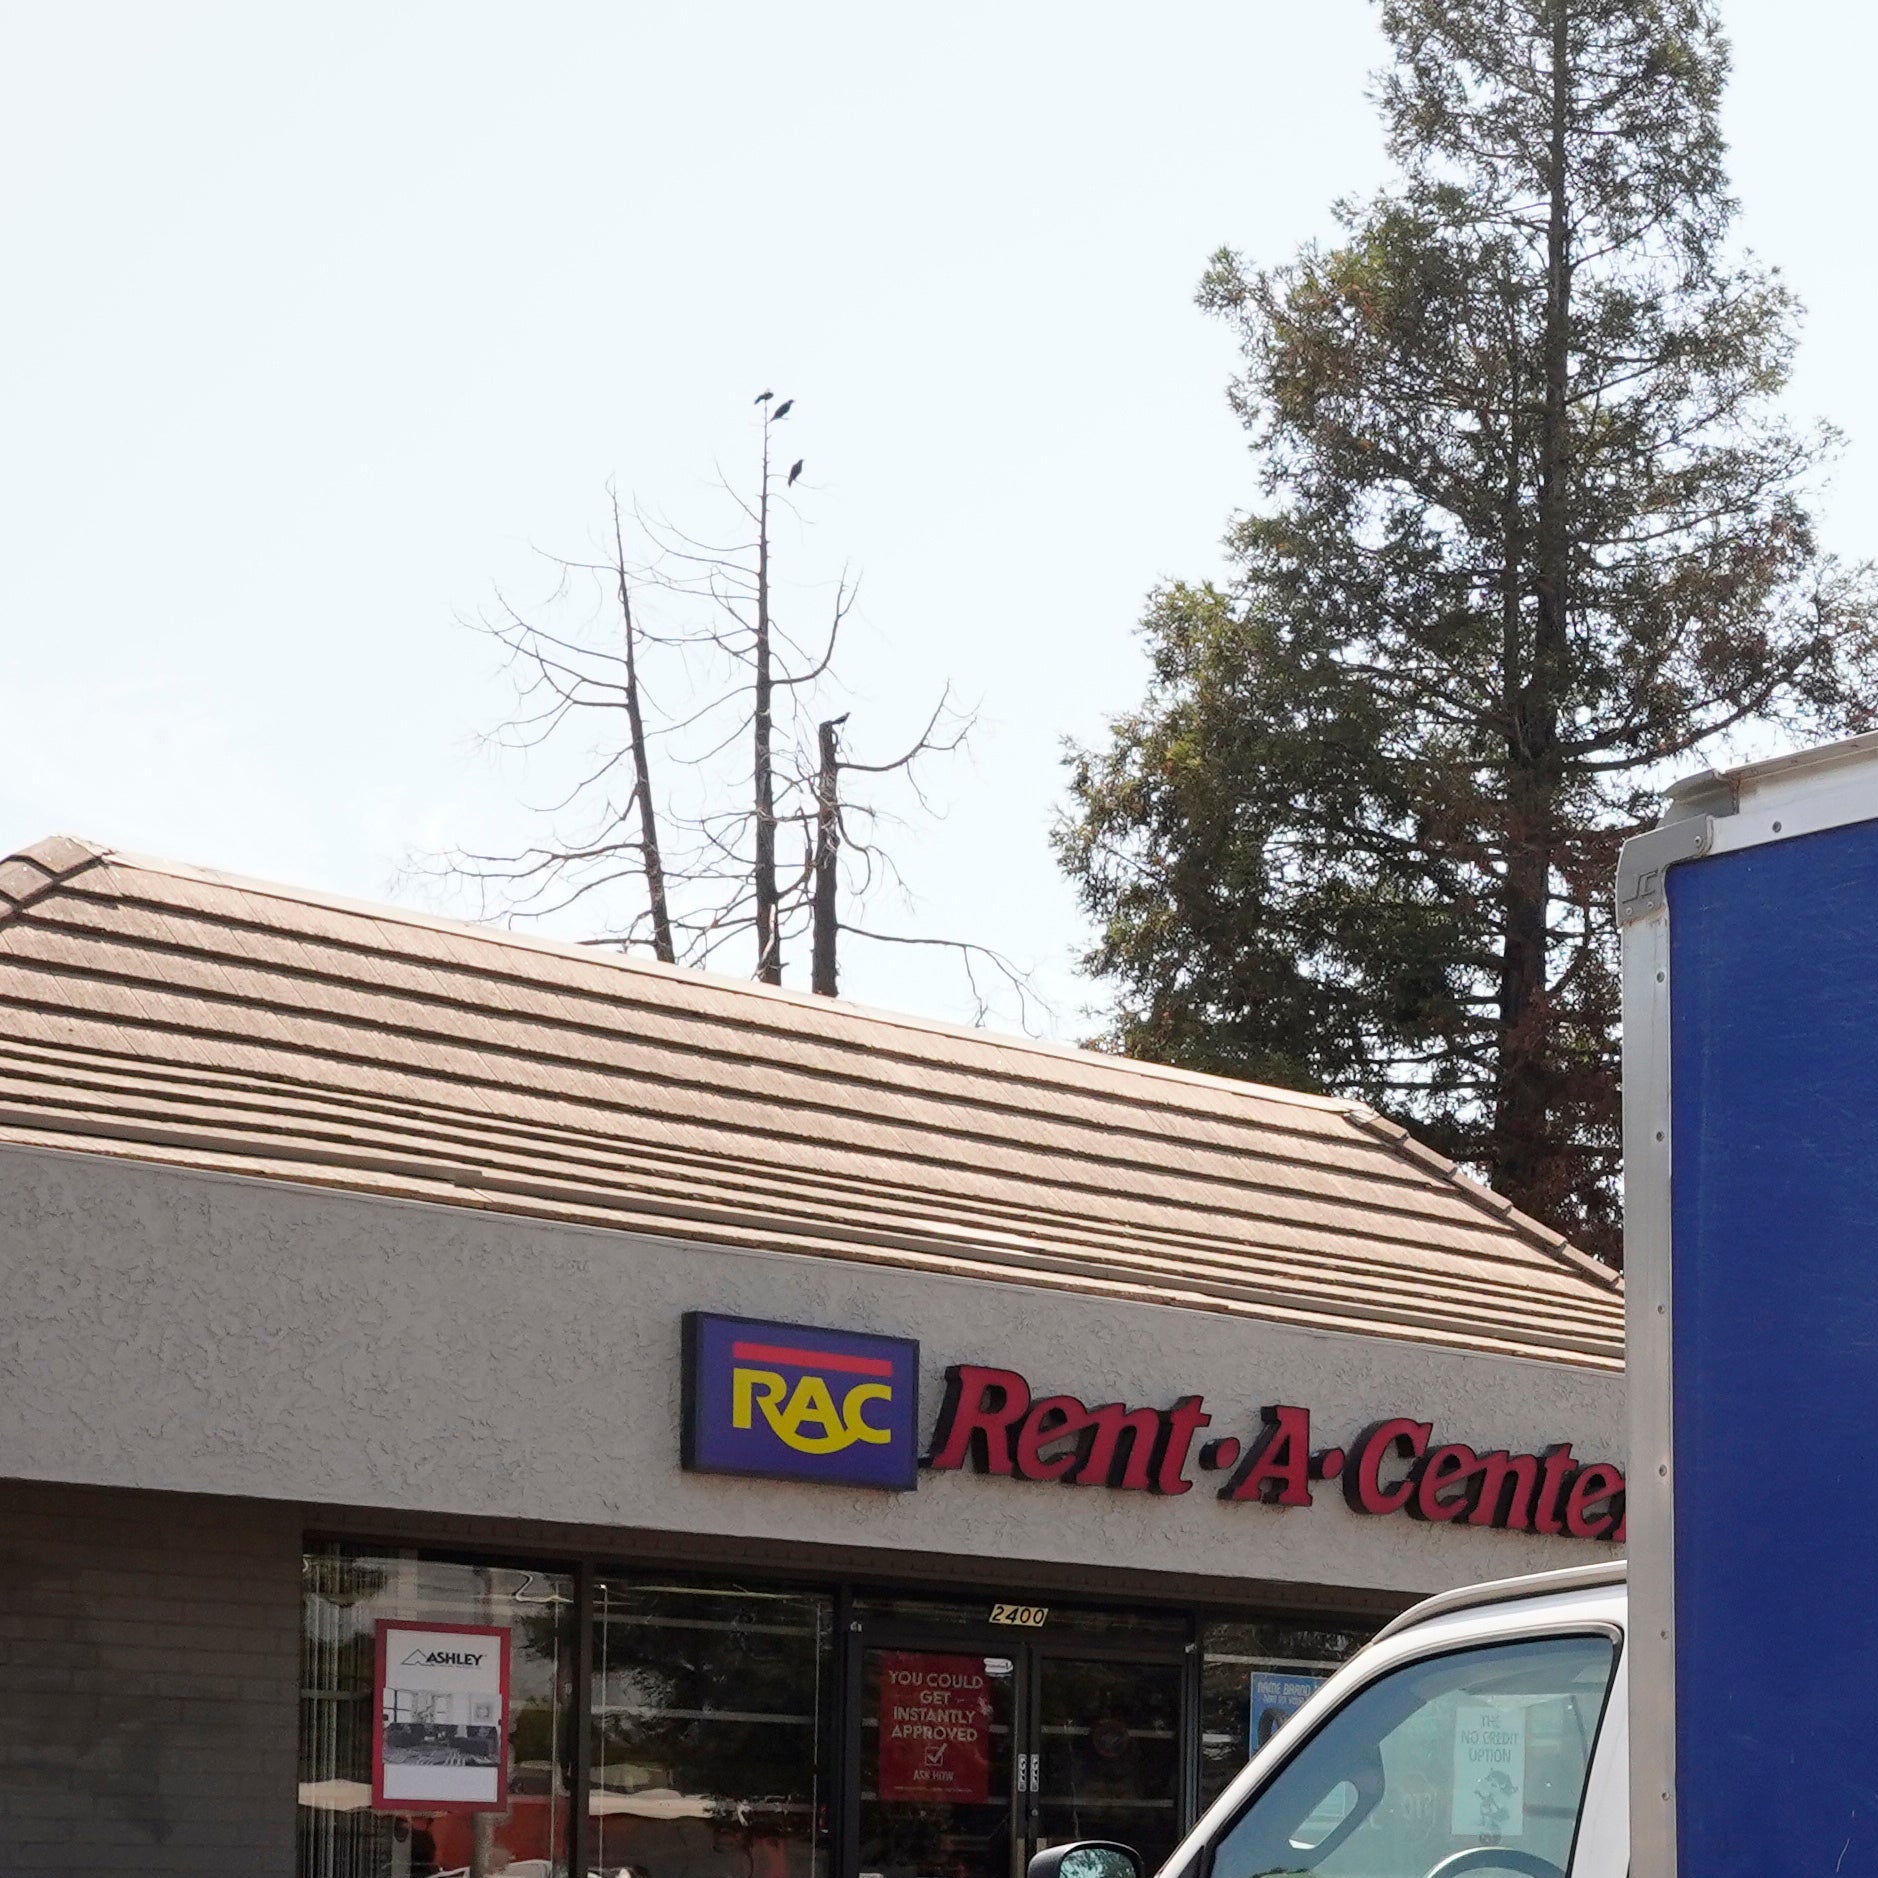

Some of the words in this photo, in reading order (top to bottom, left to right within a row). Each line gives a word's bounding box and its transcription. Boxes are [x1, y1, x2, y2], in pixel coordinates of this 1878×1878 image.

[733, 1368, 892, 1454] RAC
[993, 1606, 1045, 1624] 2400
[426, 1652, 483, 1665] ASHLEY
[888, 1671, 922, 1686] YOU
[927, 1673, 984, 1689] COULD
[920, 1691, 951, 1705] GET
[893, 1706, 976, 1724] INSTANTLY
[891, 1726, 978, 1742] APPROVED
[1461, 1731, 1479, 1745] NO
[1468, 1748, 1512, 1763] OPTION
